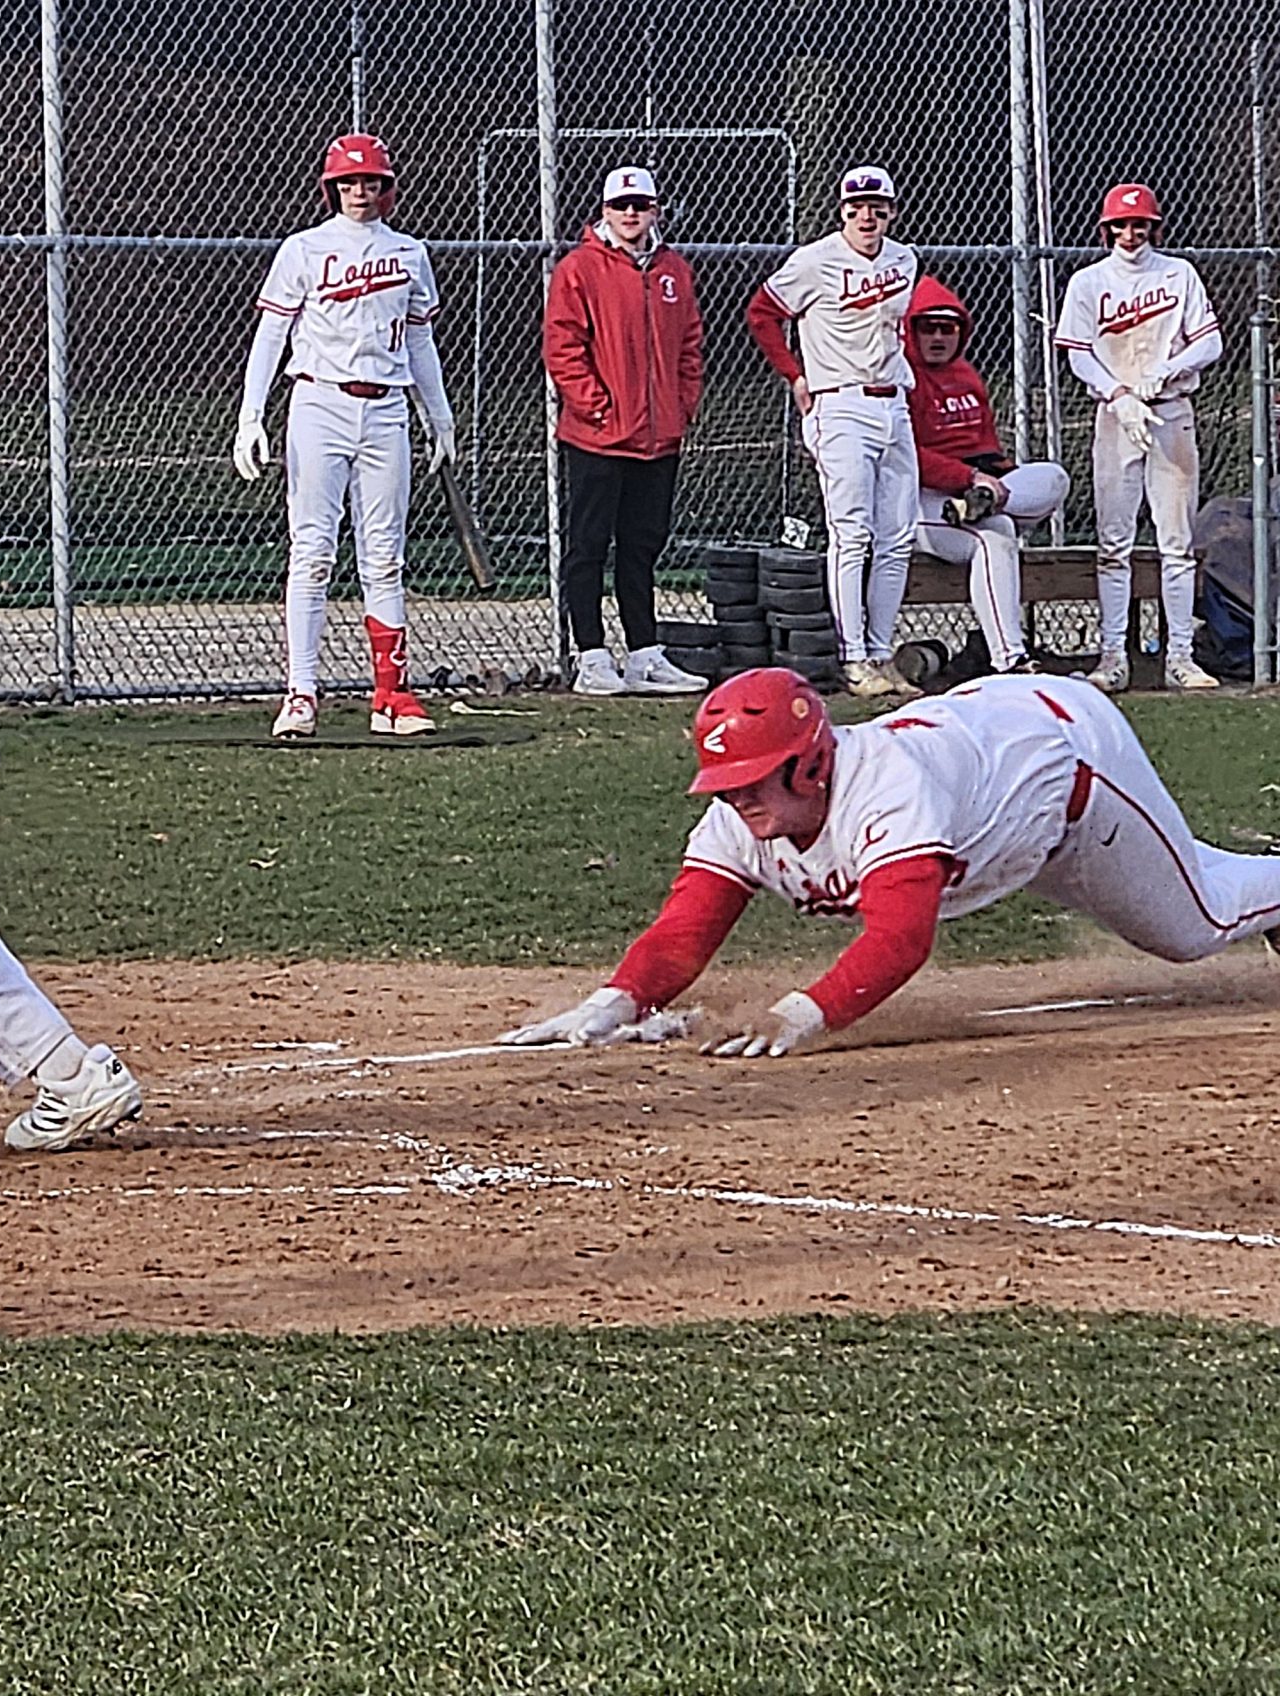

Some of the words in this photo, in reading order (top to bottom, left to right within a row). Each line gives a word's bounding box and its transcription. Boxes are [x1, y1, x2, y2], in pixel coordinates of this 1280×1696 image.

[317, 254, 410, 300] Logan
[839, 268, 909, 303] Logan
[1098, 287, 1179, 325] Logan
